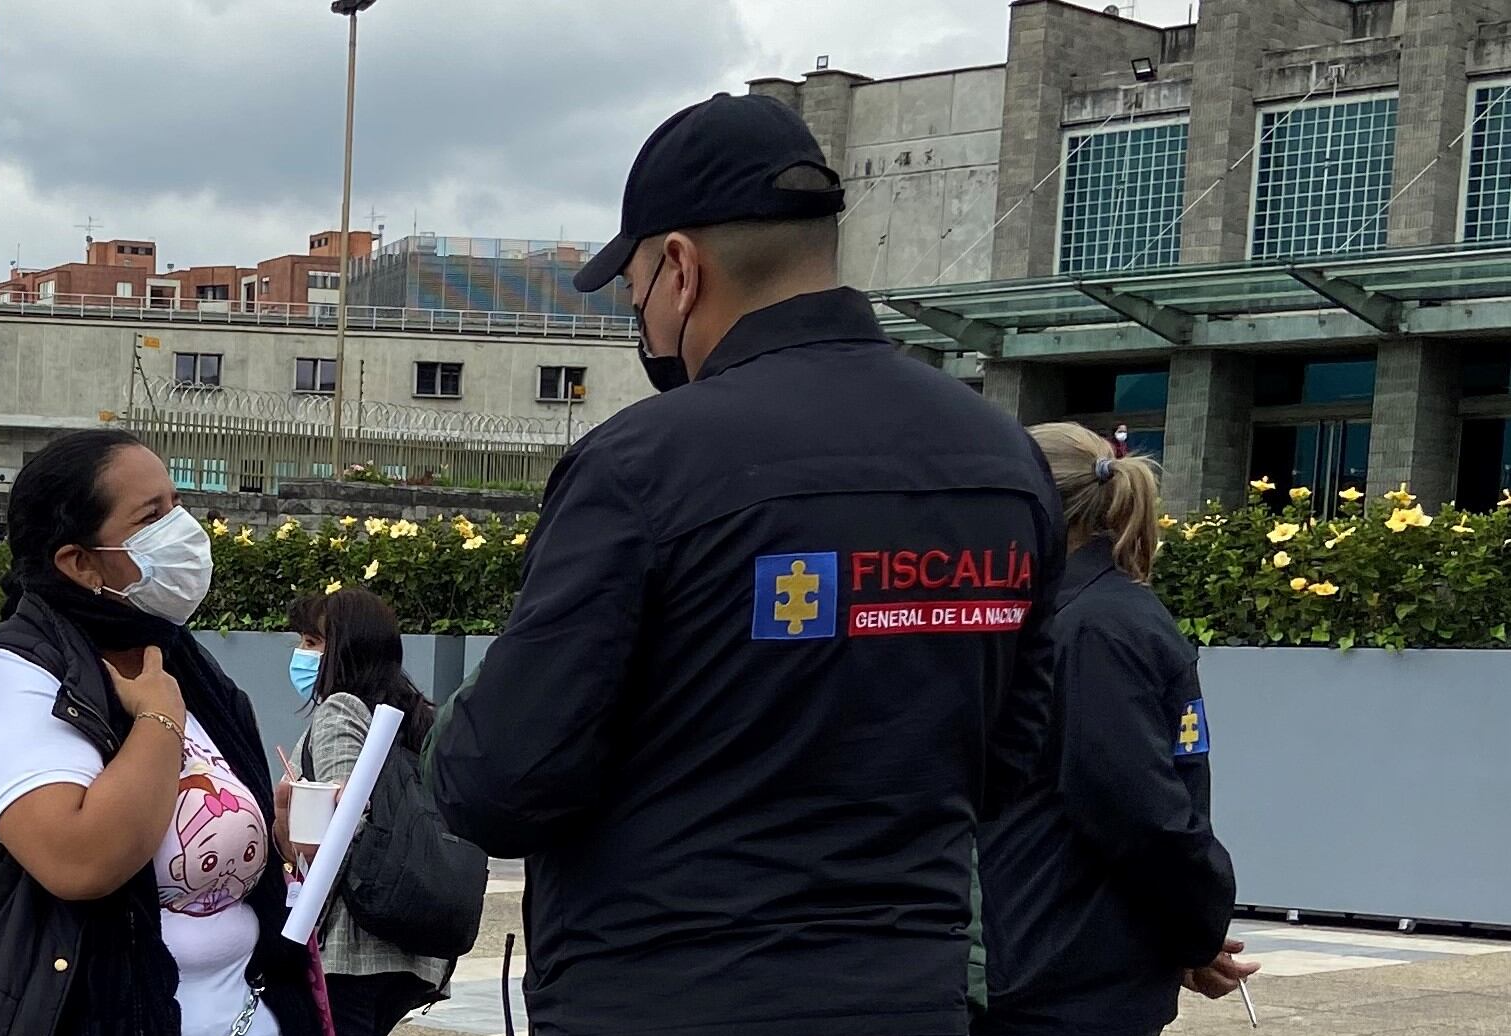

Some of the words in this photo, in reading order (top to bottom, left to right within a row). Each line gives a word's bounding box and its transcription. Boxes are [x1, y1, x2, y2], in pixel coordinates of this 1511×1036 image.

[851, 540, 1031, 591] FISCALÍA
[855, 609, 926, 628] GENERAL
[932, 608, 957, 625] DE
[961, 607, 982, 625] LA
